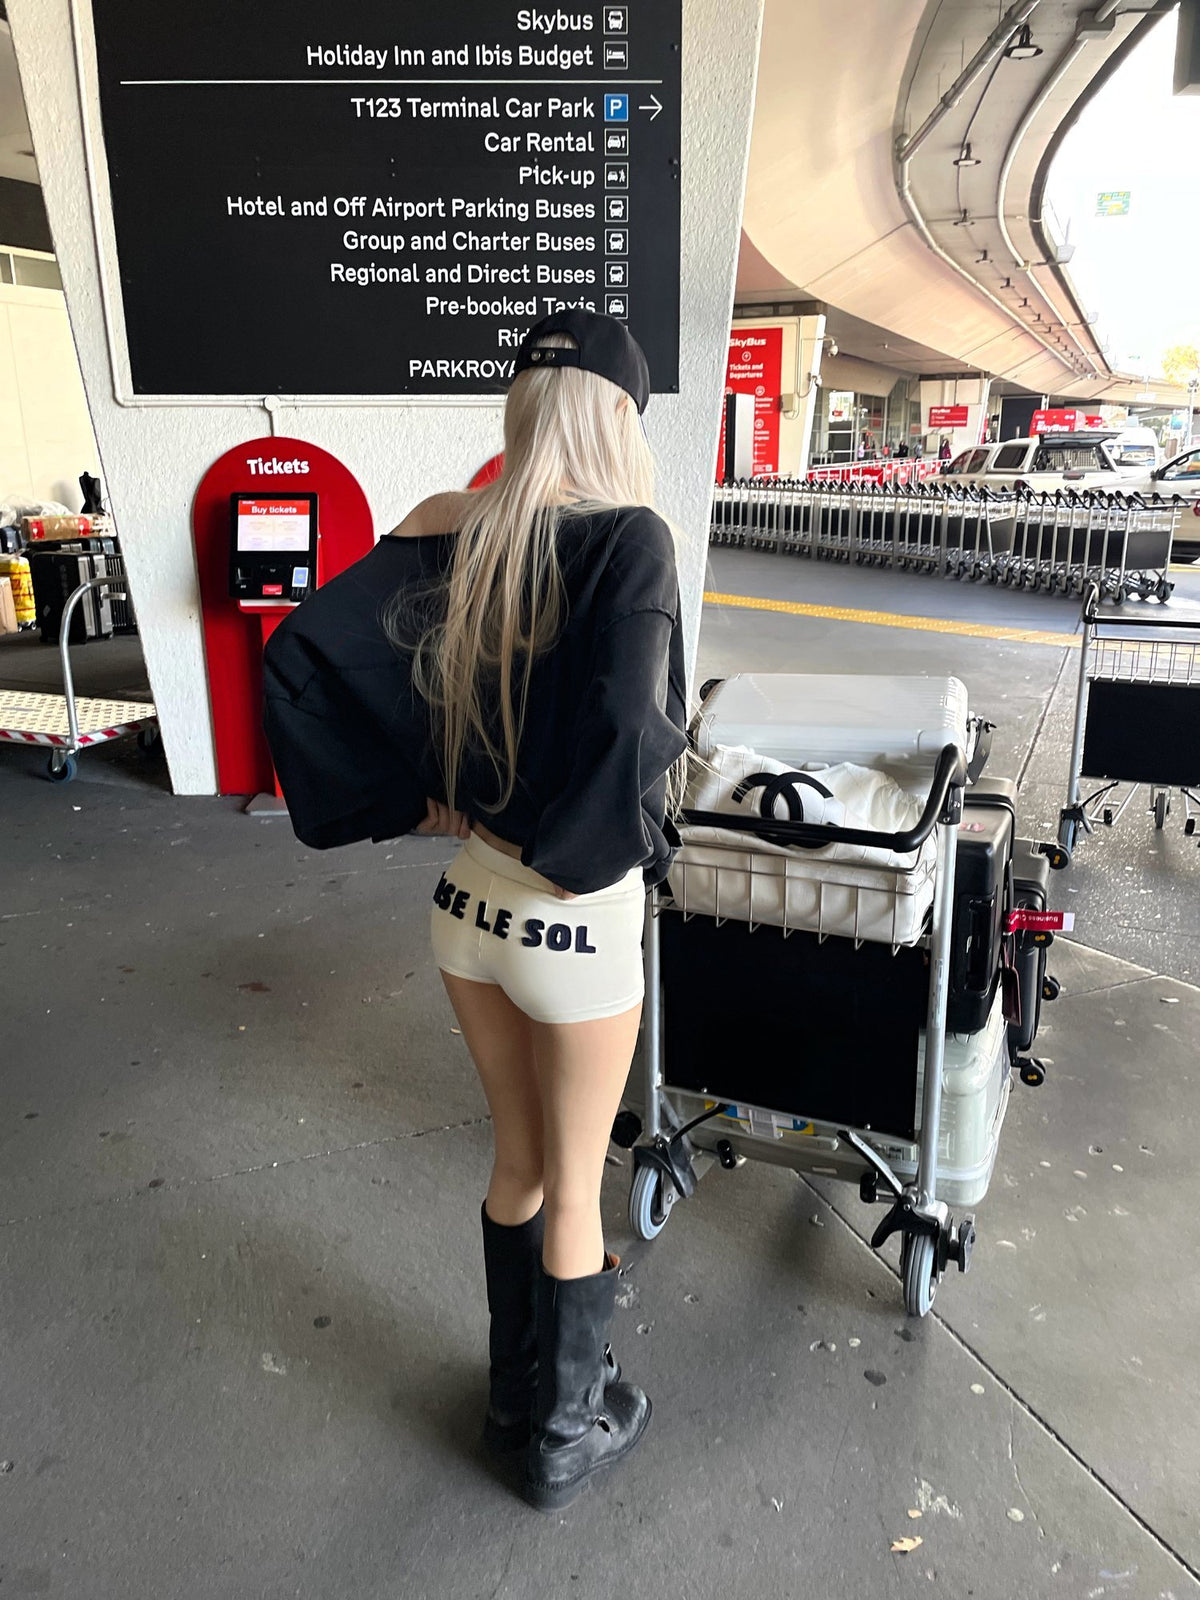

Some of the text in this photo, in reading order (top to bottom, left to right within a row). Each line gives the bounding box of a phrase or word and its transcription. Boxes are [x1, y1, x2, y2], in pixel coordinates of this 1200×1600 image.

[517, 9, 594, 34] Skybus
[306, 44, 594, 70] Holiday Inn and Ibis Budget
[350, 98, 402, 118] T123
[406, 97, 500, 118] Terminal
[505, 97, 543, 118] Car
[548, 97, 595, 118] Park
[484, 131, 595, 152] Car Rental
[519, 165, 595, 188] Pick-up
[226, 196, 596, 222] Hotel and Off Airport Parking Buses
[343, 230, 596, 254] Group and Charter Buses
[330, 262, 596, 286] Regional and Direct Buses
[426, 296, 537, 316] Pre-booked
[729, 338, 767, 348] SkyBus
[730, 363, 751, 371] Tickets
[730, 372, 763, 380] Departures
[246, 457, 310, 475] Tickets
[251, 506, 297, 515] Buy tickets
[475, 901, 512, 939] LE
[521, 919, 597, 954] SOL
